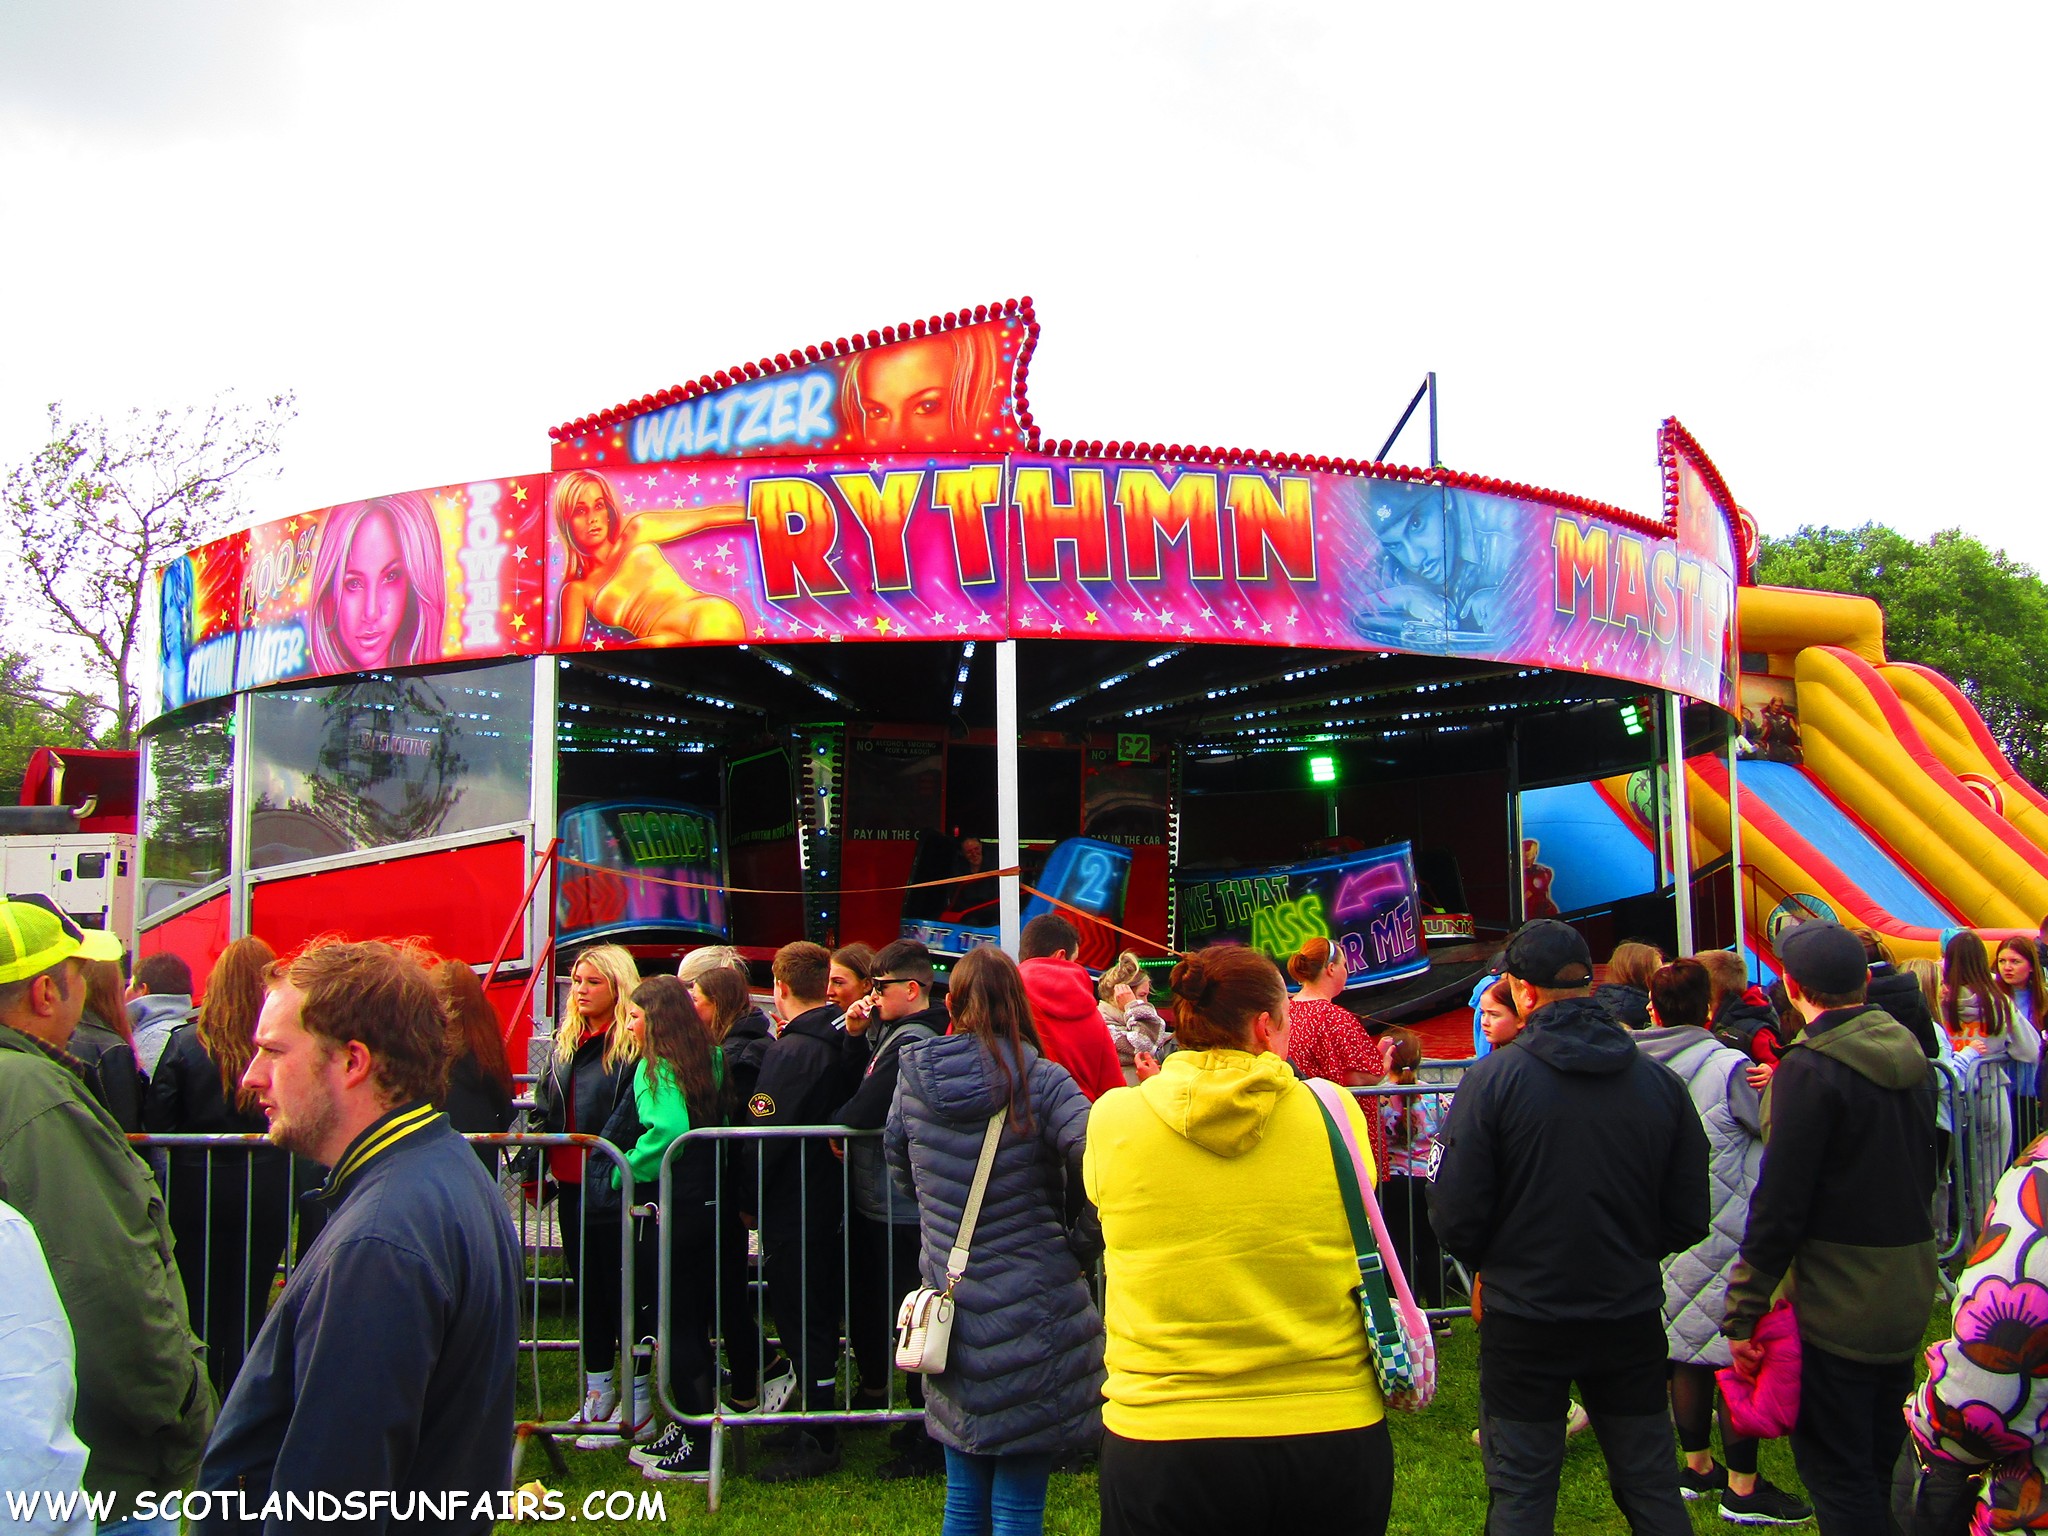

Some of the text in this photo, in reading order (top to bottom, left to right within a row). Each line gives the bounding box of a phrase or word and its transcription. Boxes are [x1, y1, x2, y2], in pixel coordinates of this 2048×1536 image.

[635, 375, 832, 462] WALTZER
[748, 464, 1318, 601] RYTHMN
[244, 525, 317, 620] 100%
[462, 482, 504, 645] POWER
[1551, 517, 1733, 670] MASTE
[237, 626, 304, 692] MASTER
[856, 741, 874, 752] NO
[875, 740, 905, 748] ALCOHOL
[1091, 750, 1107, 760] NO
[1120, 736, 1149, 759] £2
[853, 829, 921, 841] PAY IN THE C
[1111, 835, 1121, 844] IN
[1124, 835, 1141, 845] THE
[1143, 836, 1161, 845] CAR
[1074, 852, 1112, 906] 2
[1177, 874, 1289, 934] AKE THAT
[900, 924, 954, 949] NT
[1253, 894, 1330, 957] ASS
[1339, 895, 1417, 974] R ME
[1422, 919, 1474, 935] UNK
